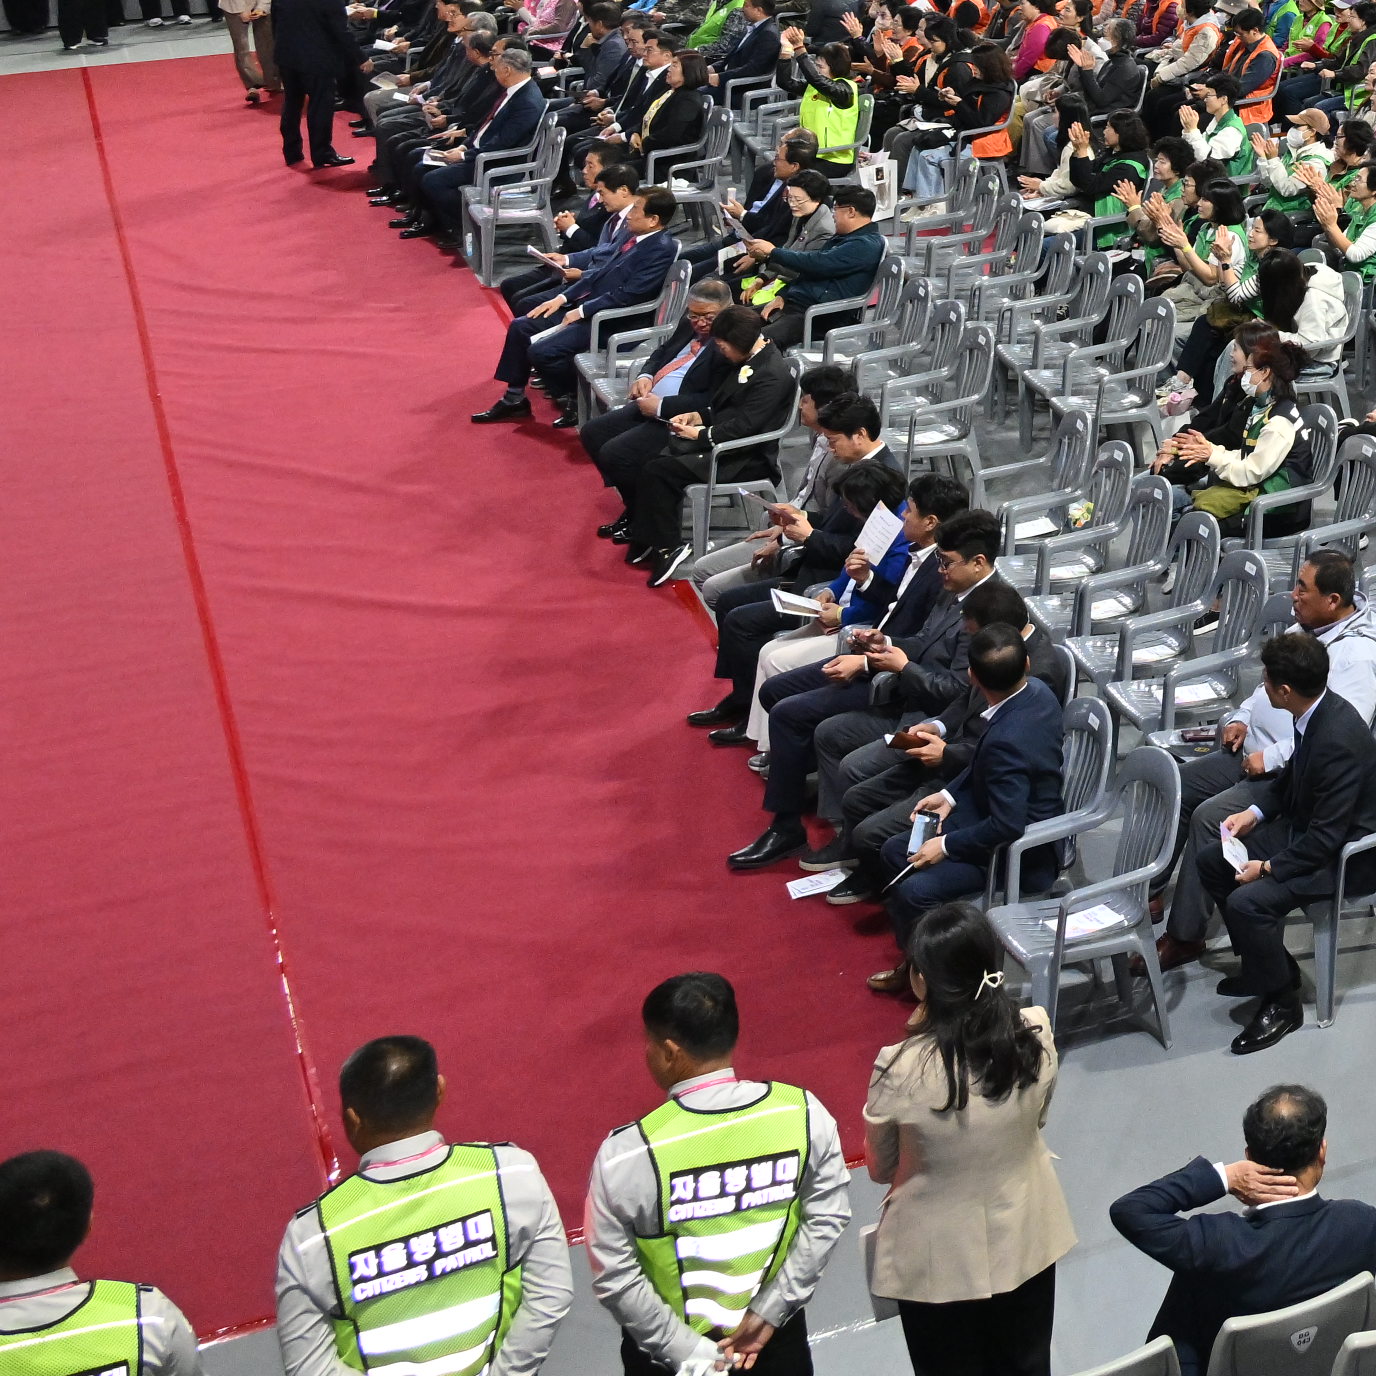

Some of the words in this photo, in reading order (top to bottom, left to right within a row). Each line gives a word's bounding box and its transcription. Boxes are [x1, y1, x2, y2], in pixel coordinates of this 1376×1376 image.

[669, 1156, 799, 1201] 자율방범대
[668, 1195, 736, 1222] CITIZENS
[738, 1183, 797, 1211] PATROL
[350, 1212, 494, 1283] 자율방범대
[352, 1265, 428, 1303] CITIZENS
[432, 1241, 498, 1280] PATROL
[1298, 1331, 1310, 1340] BG
